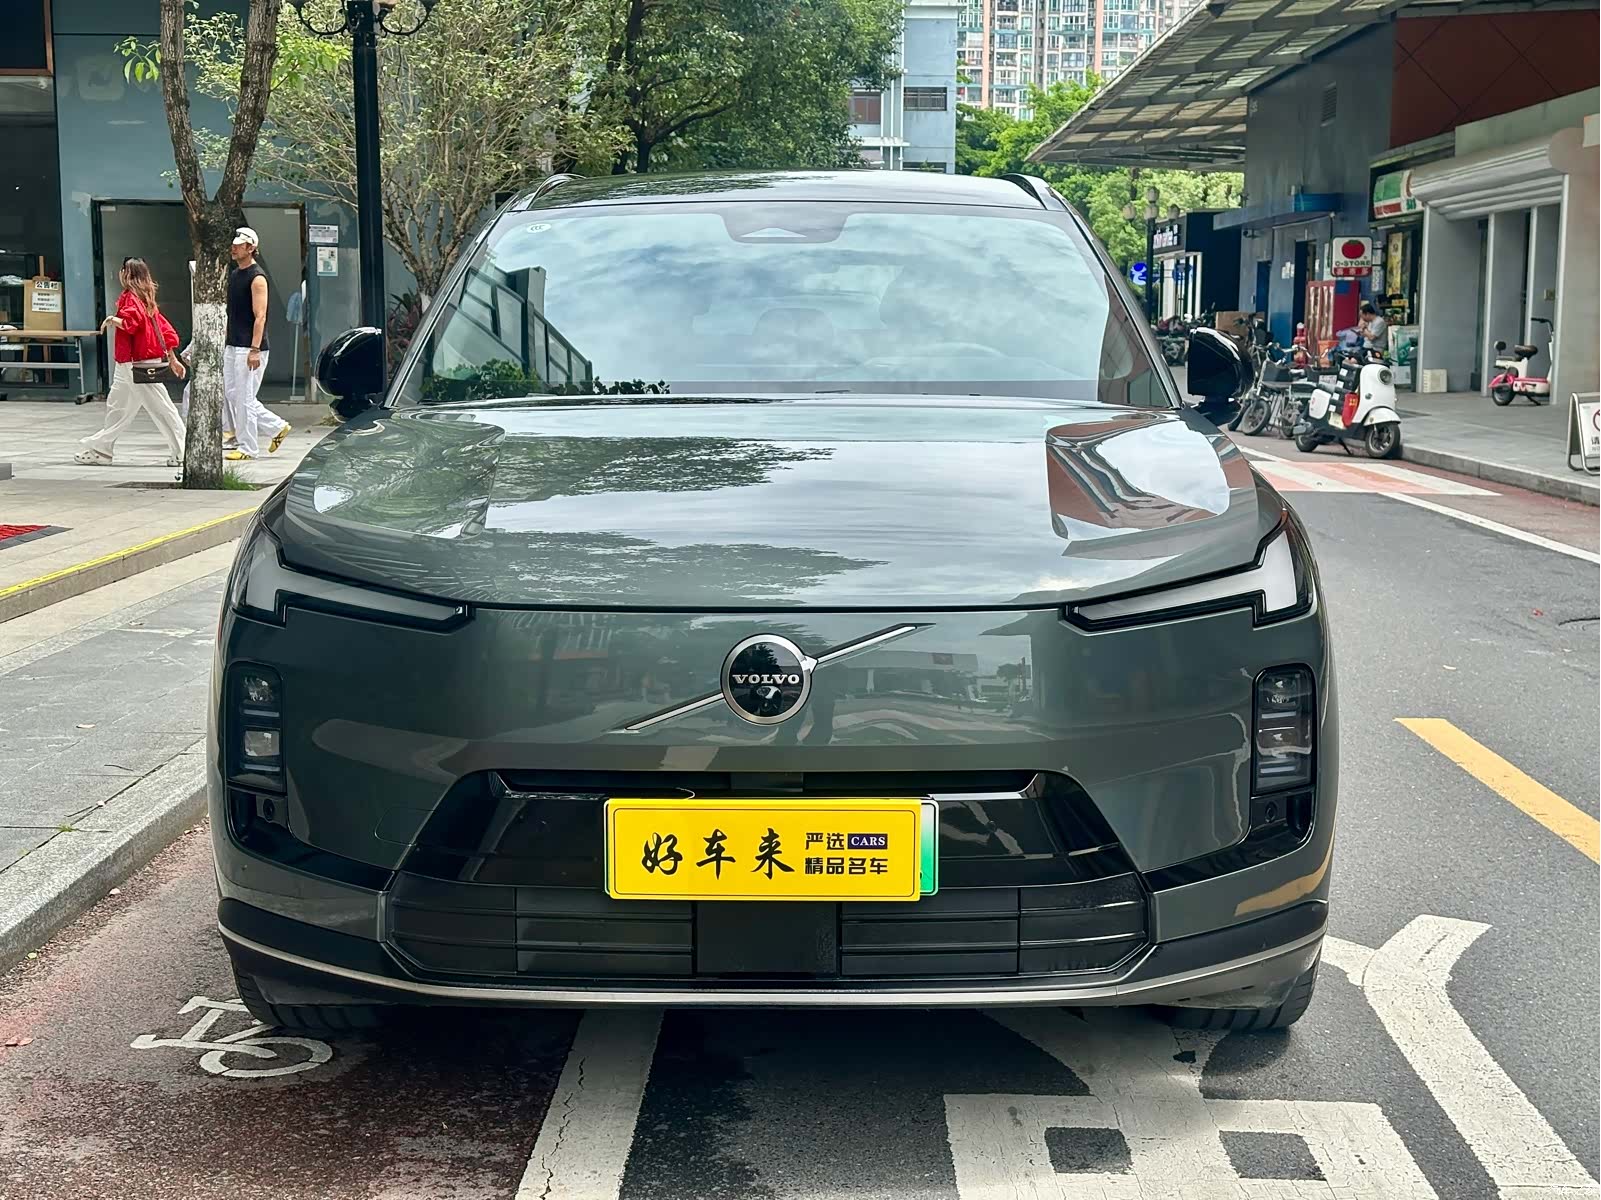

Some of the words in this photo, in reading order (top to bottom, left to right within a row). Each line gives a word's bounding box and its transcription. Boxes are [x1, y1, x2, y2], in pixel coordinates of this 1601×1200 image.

[732, 674, 800, 684] VOLVO
[805, 832, 845, 850] 严选
[850, 836, 886, 846] CARS
[641, 828, 795, 880] 好车来
[805, 857, 889, 874] 精品名车
